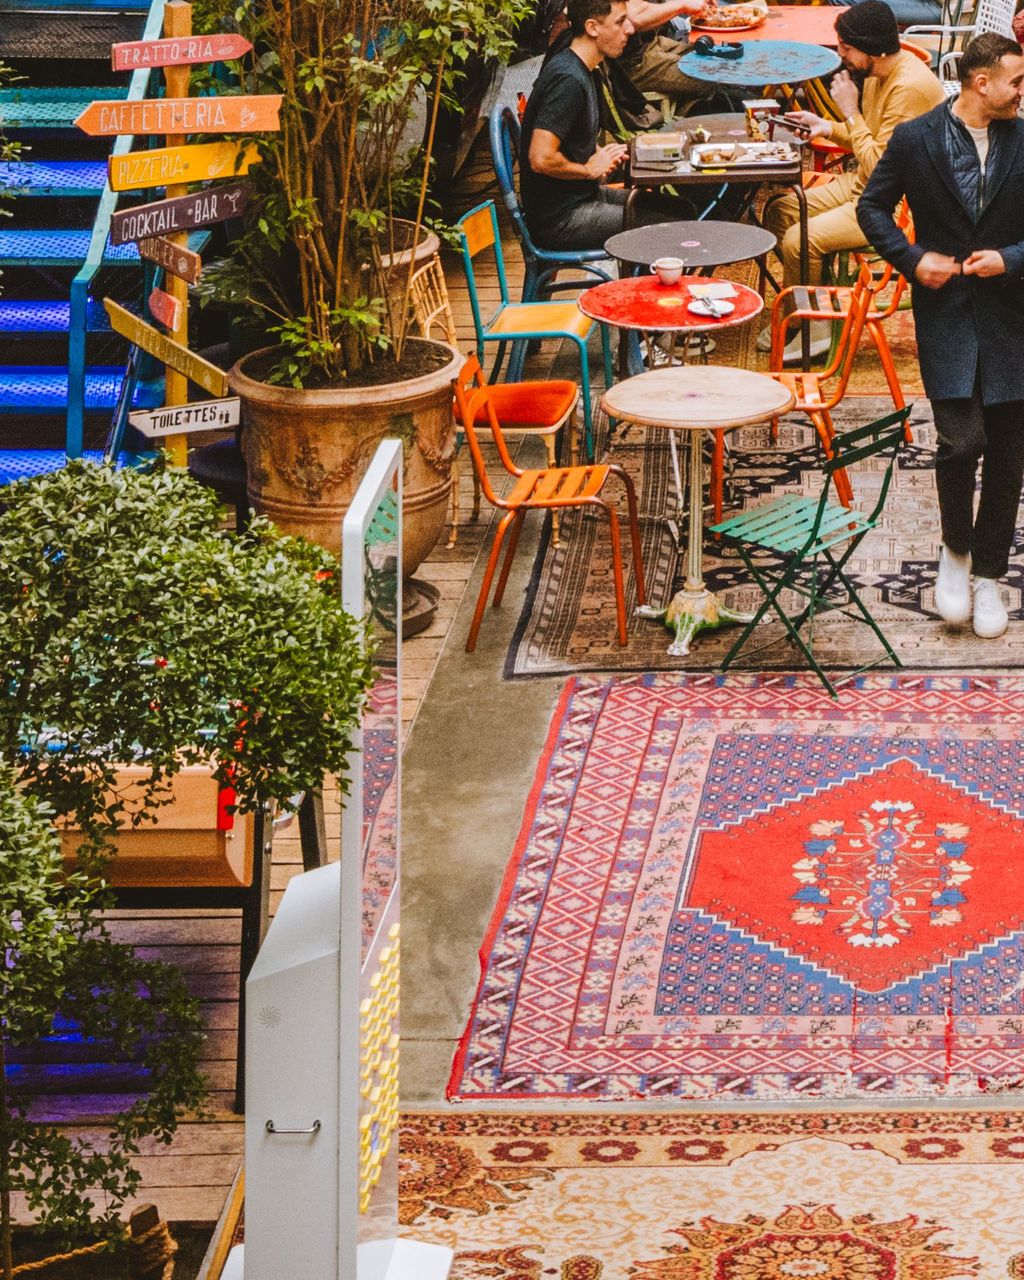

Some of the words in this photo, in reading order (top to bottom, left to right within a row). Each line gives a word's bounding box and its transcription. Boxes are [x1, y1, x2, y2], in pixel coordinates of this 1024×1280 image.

[100, 102, 226, 133] CAFFETTERIA
[118, 155, 184, 185] PIZZERIA
[122, 206, 178, 241] COCKTAIL
[194, 195, 218, 224] BAR
[150, 405, 218, 430] TOILETTES
